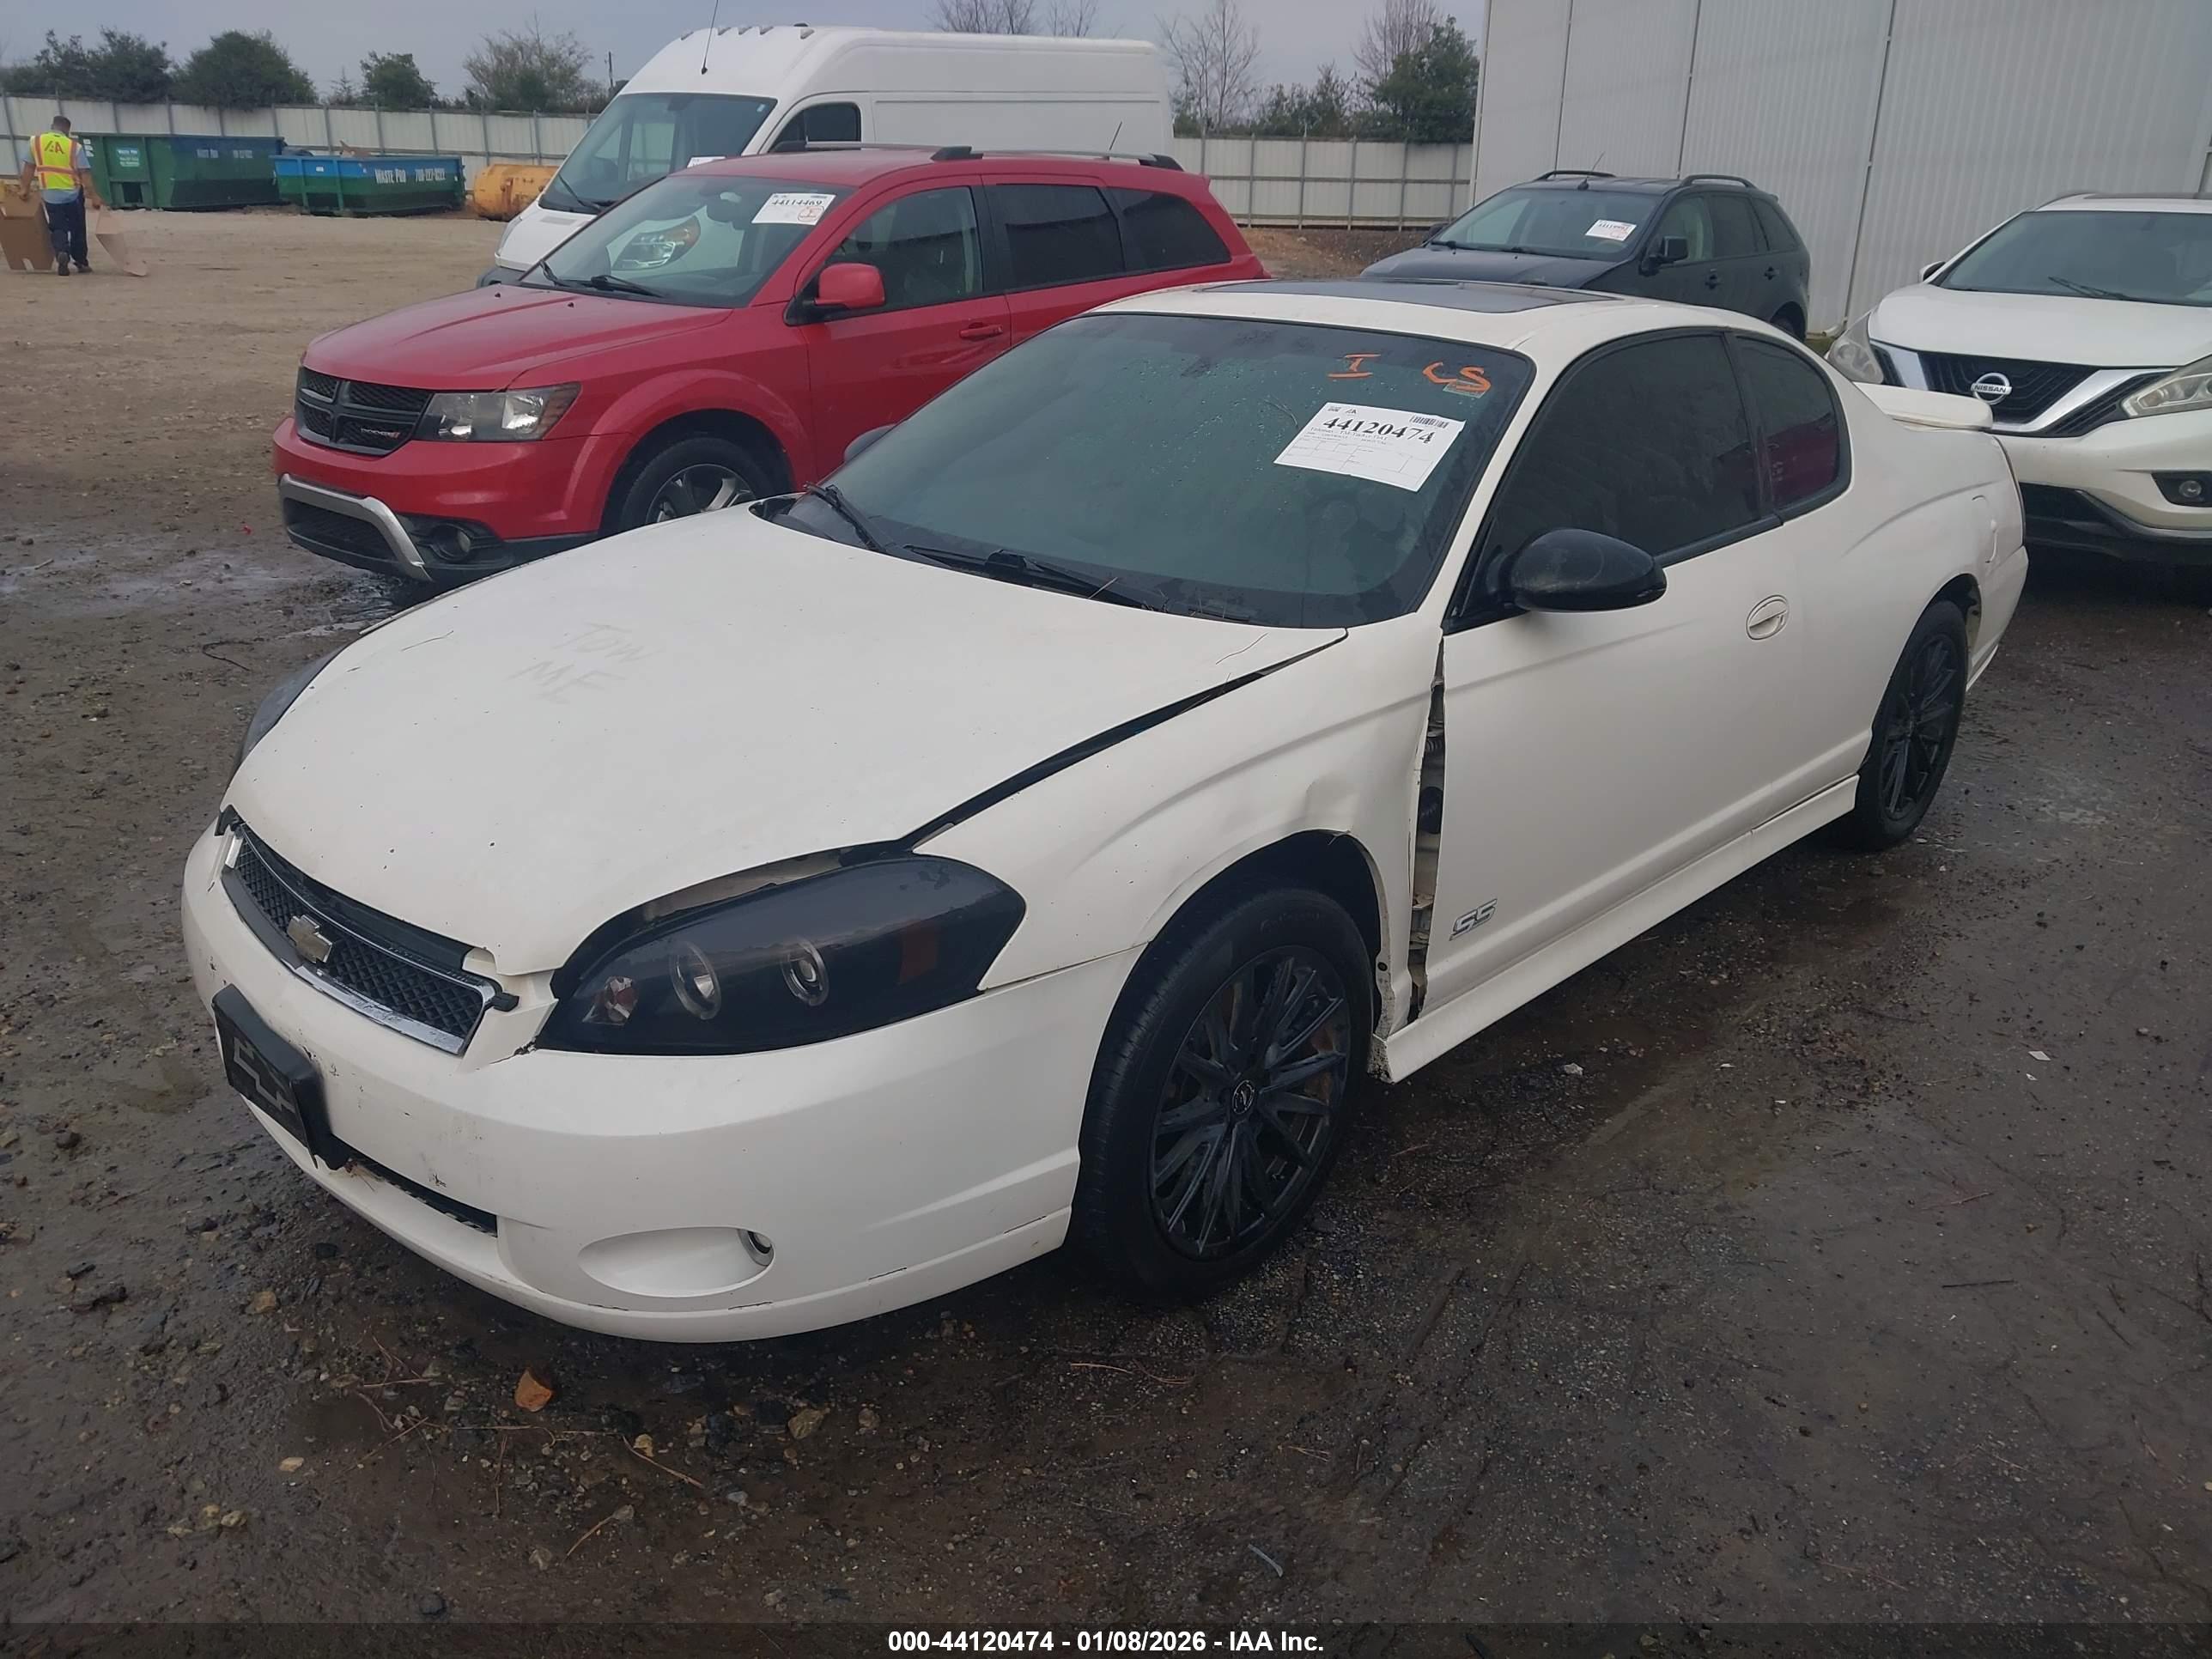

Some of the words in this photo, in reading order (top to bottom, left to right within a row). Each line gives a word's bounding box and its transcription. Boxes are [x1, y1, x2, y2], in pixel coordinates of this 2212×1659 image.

[1974, 384, 2007, 393] NISSAN
[1322, 417, 1435, 444] 44120474
[1449, 898, 1498, 941] SS
